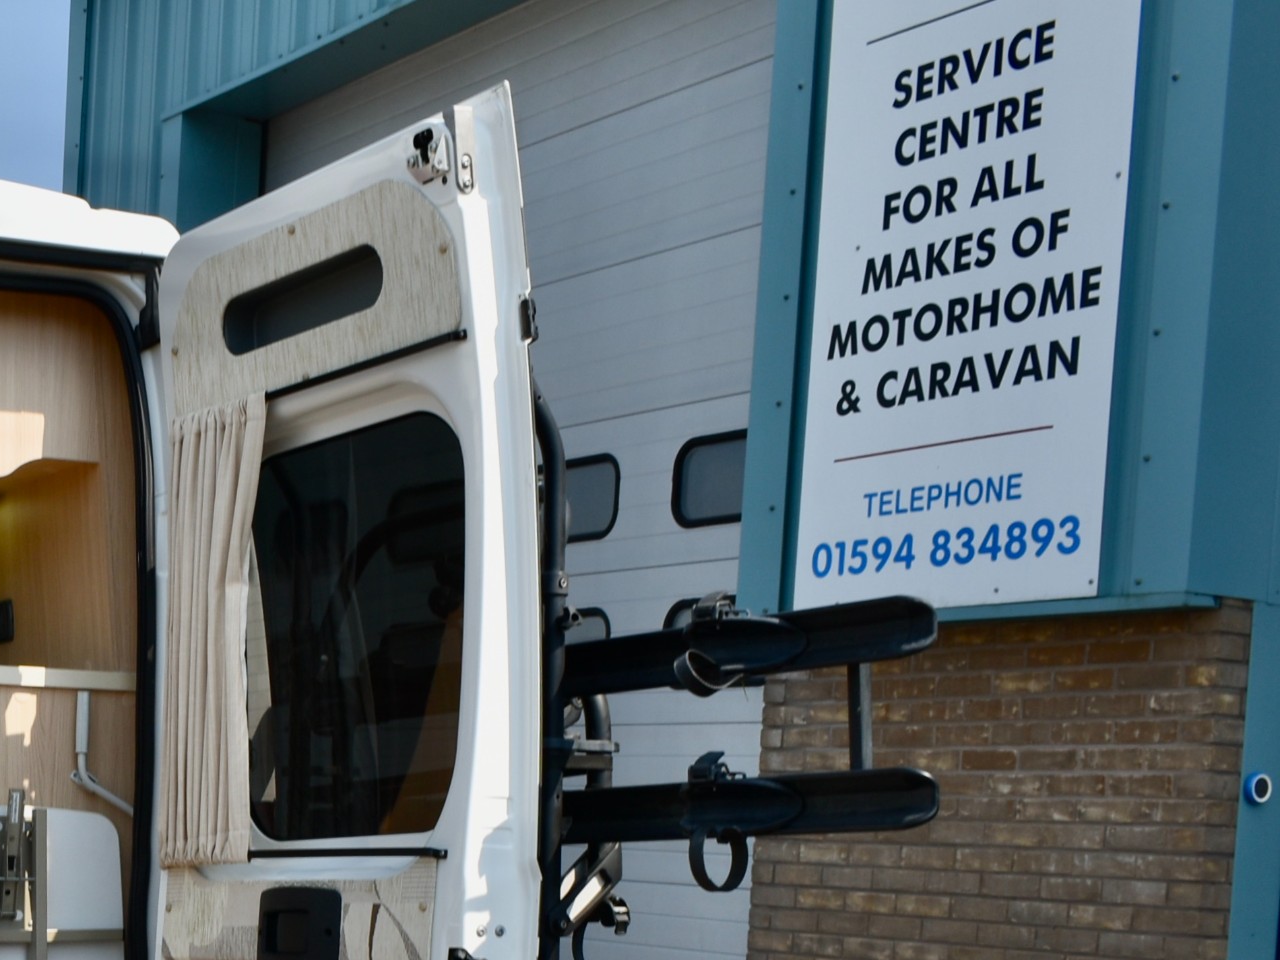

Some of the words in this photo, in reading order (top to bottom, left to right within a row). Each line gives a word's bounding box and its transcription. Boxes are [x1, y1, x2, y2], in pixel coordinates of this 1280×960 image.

[892, 19, 1056, 109] SERVICE
[894, 87, 1044, 167] CENTRE
[882, 176, 958, 231] FOR
[970, 152, 1045, 208] ALL
[860, 227, 996, 296] MAKES
[1011, 207, 1070, 258] OF
[826, 265, 1103, 361] MOTORHOME
[835, 379, 862, 416] &
[875, 335, 1081, 409] CARAVAN
[862, 472, 1024, 518] TELEPHONE
[811, 532, 916, 579] 01594
[928, 514, 1081, 567] 834893
